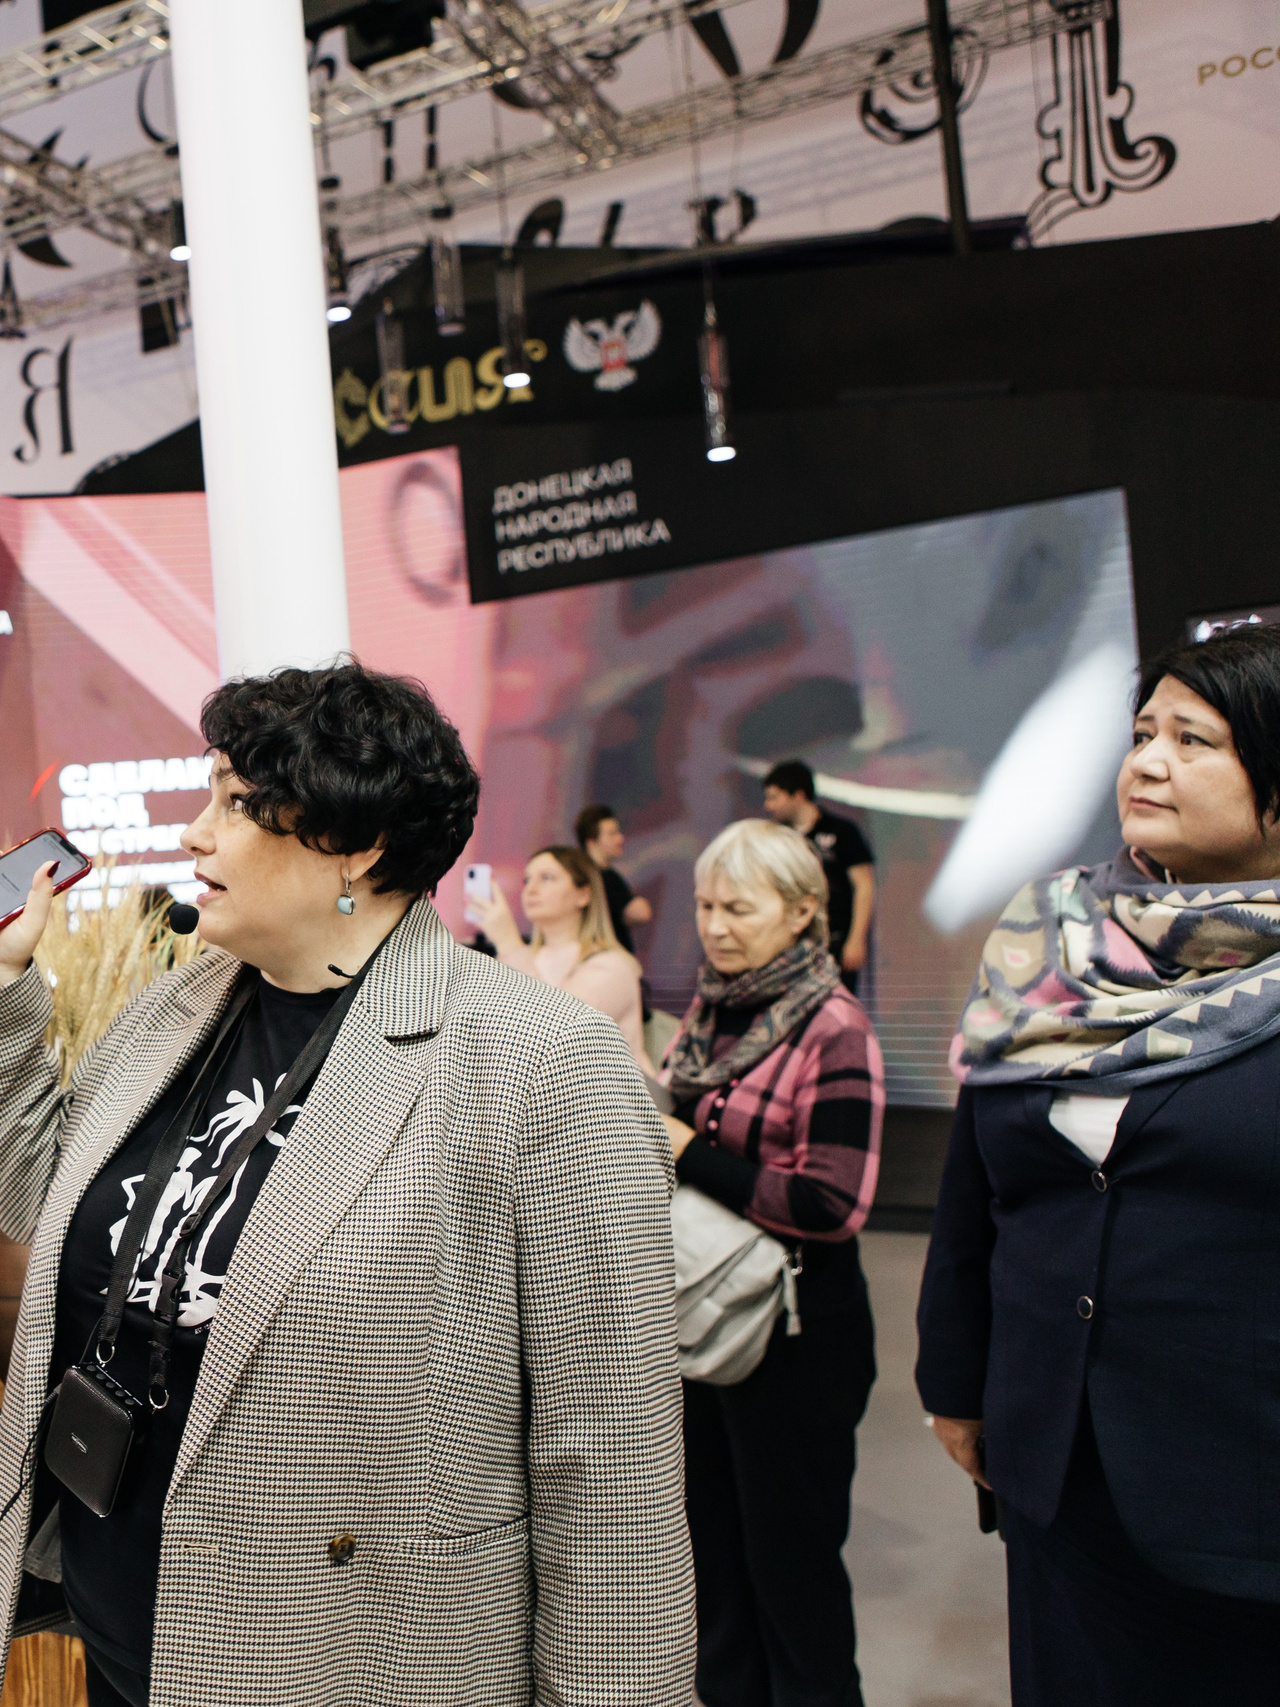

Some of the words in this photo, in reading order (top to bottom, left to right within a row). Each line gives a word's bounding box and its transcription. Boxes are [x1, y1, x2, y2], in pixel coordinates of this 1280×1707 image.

[1198, 46, 1280, 85] РОС
[492, 457, 633, 516] ДОНЕЦКАЯ
[495, 490, 638, 543] НАРОДНАЯ
[497, 518, 671, 574] РЕСПУБЛИКА
[59, 756, 214, 799] СДЕЛАН
